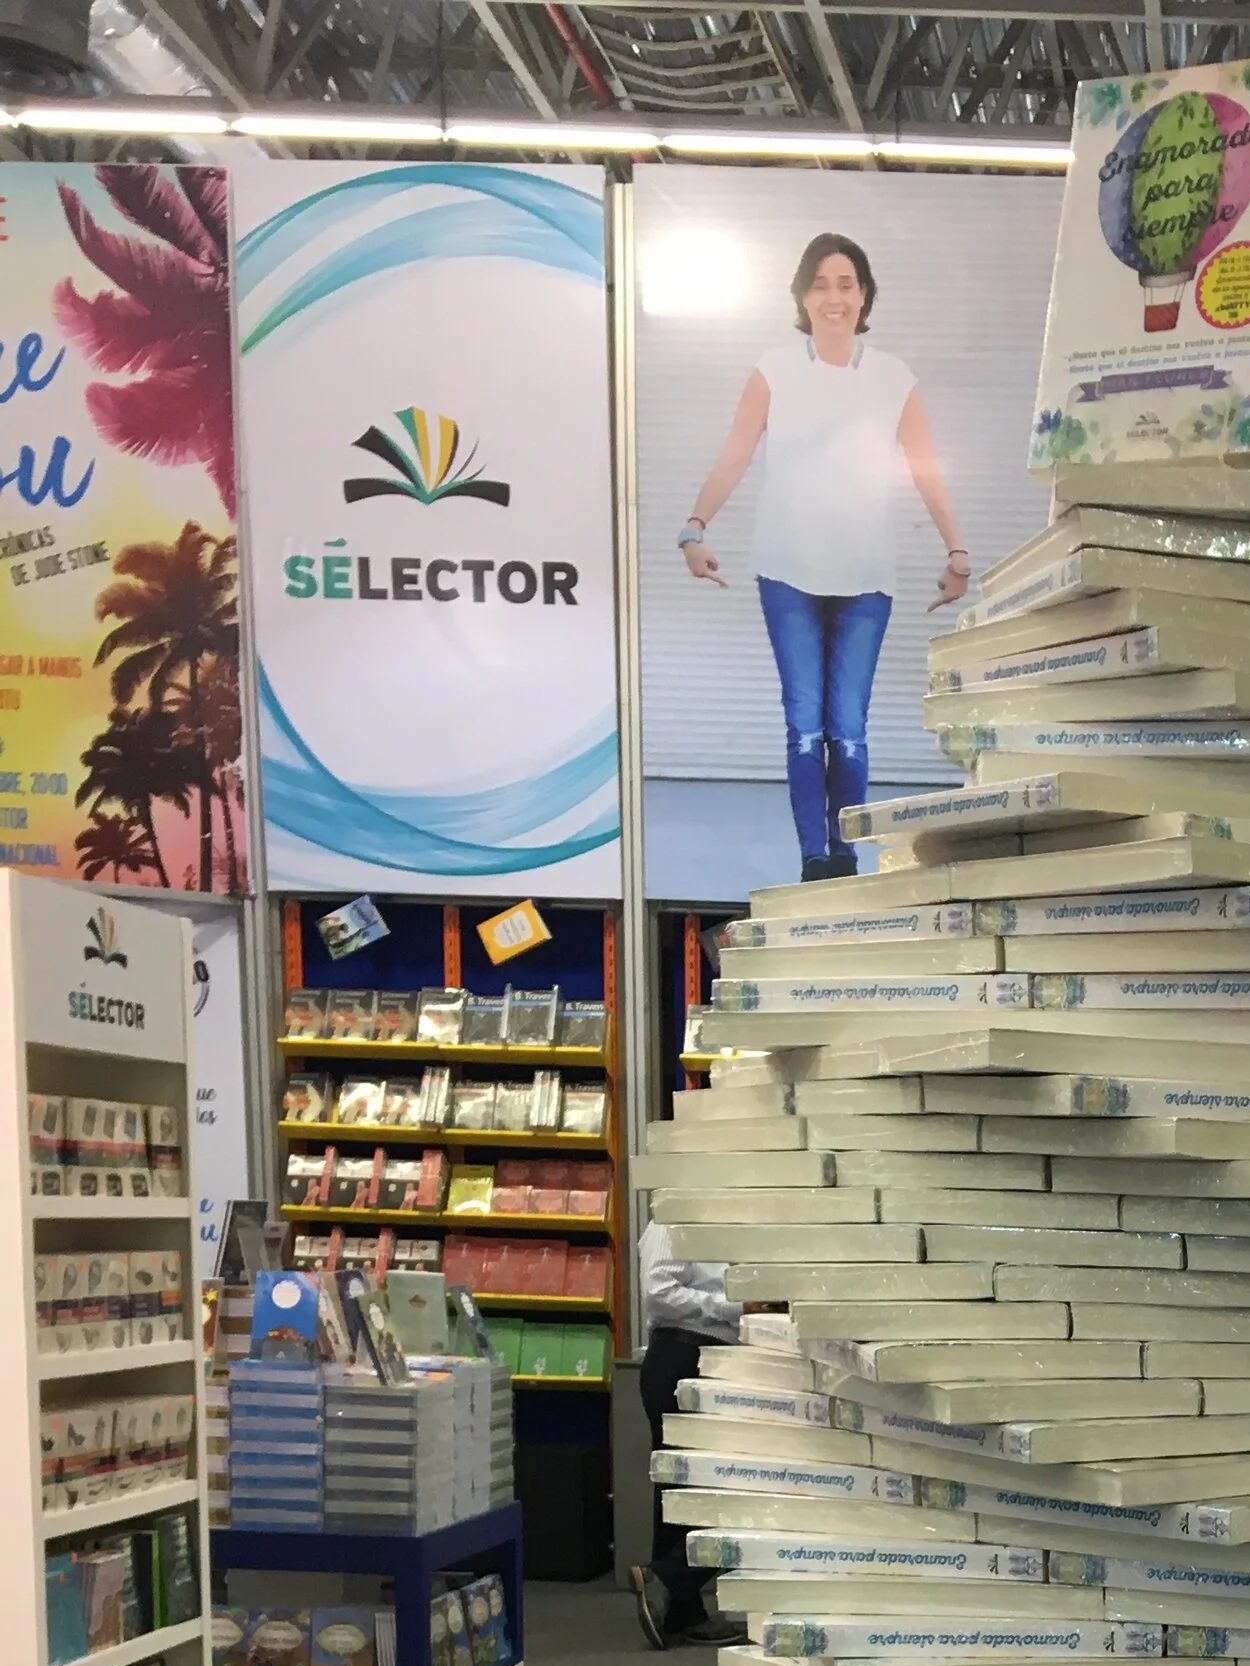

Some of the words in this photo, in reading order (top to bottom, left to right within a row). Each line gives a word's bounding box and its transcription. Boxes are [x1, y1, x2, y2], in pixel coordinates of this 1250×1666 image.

[1142, 172, 1219, 211] para
[1121, 979, 1176, 996] siempre
[1183, 979, 1219, 994] para
[1165, 1090, 1220, 1109] siempre
[776, 1545, 835, 1563] siempre
[837, 1547, 875, 1563] para
[878, 1551, 966, 1569] Enamorada
[867, 1631, 935, 1647] siempre
[939, 1631, 980, 1645] para
[982, 1633, 1080, 1649] Enamorada
